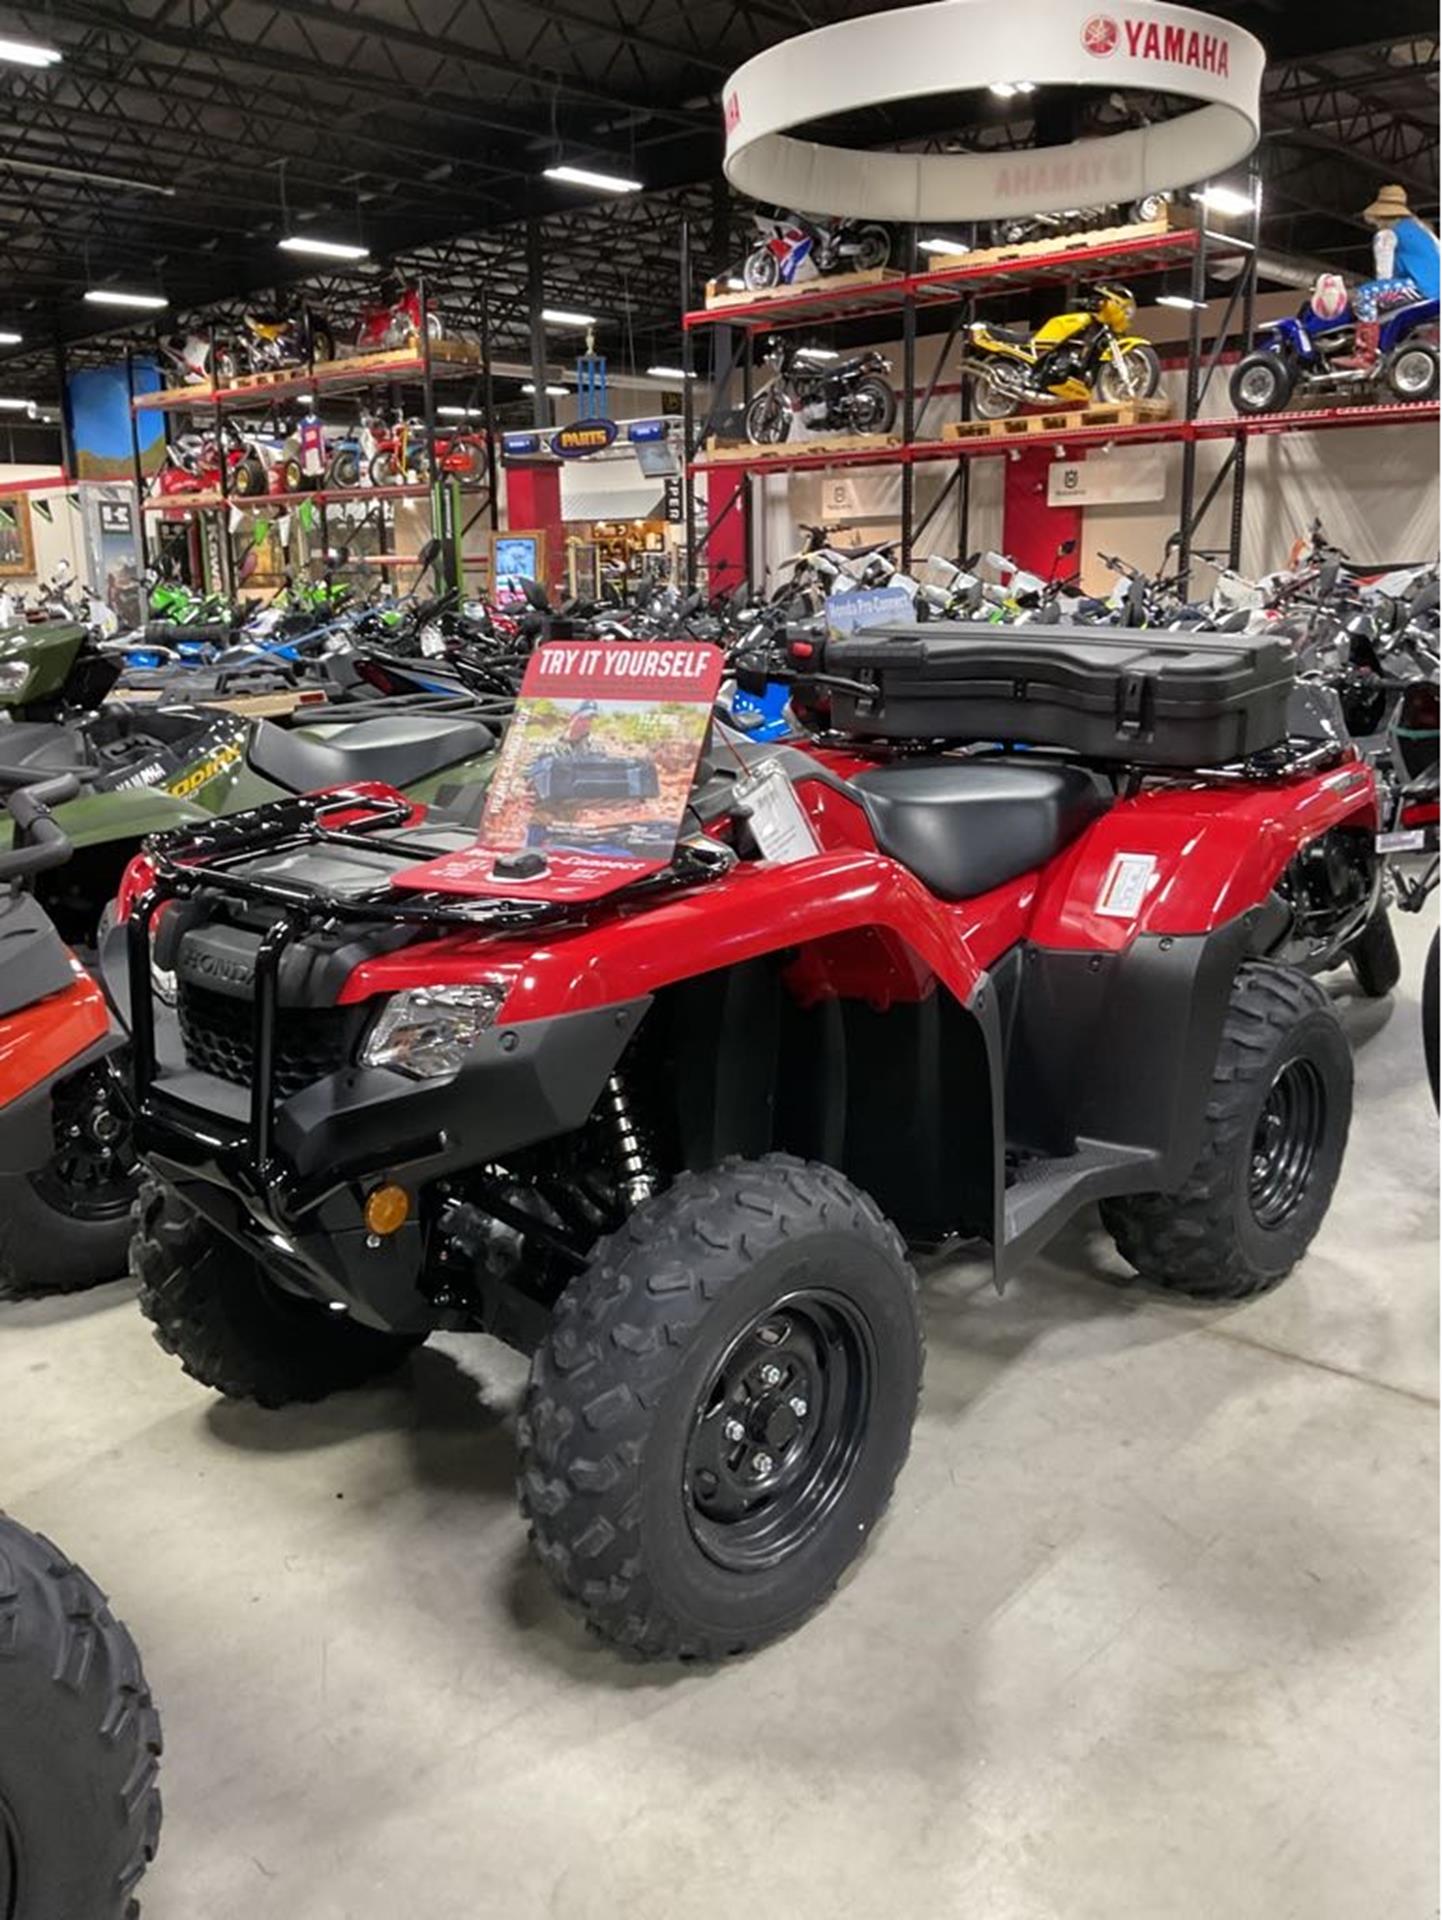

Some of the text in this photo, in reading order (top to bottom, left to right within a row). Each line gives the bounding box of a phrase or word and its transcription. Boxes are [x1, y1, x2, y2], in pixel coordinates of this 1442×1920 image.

[1124, 20, 1230, 78] YAMAHA
[561, 430, 607, 448] PARTS
[539, 650, 711, 678] TRY IT YOURSELF
